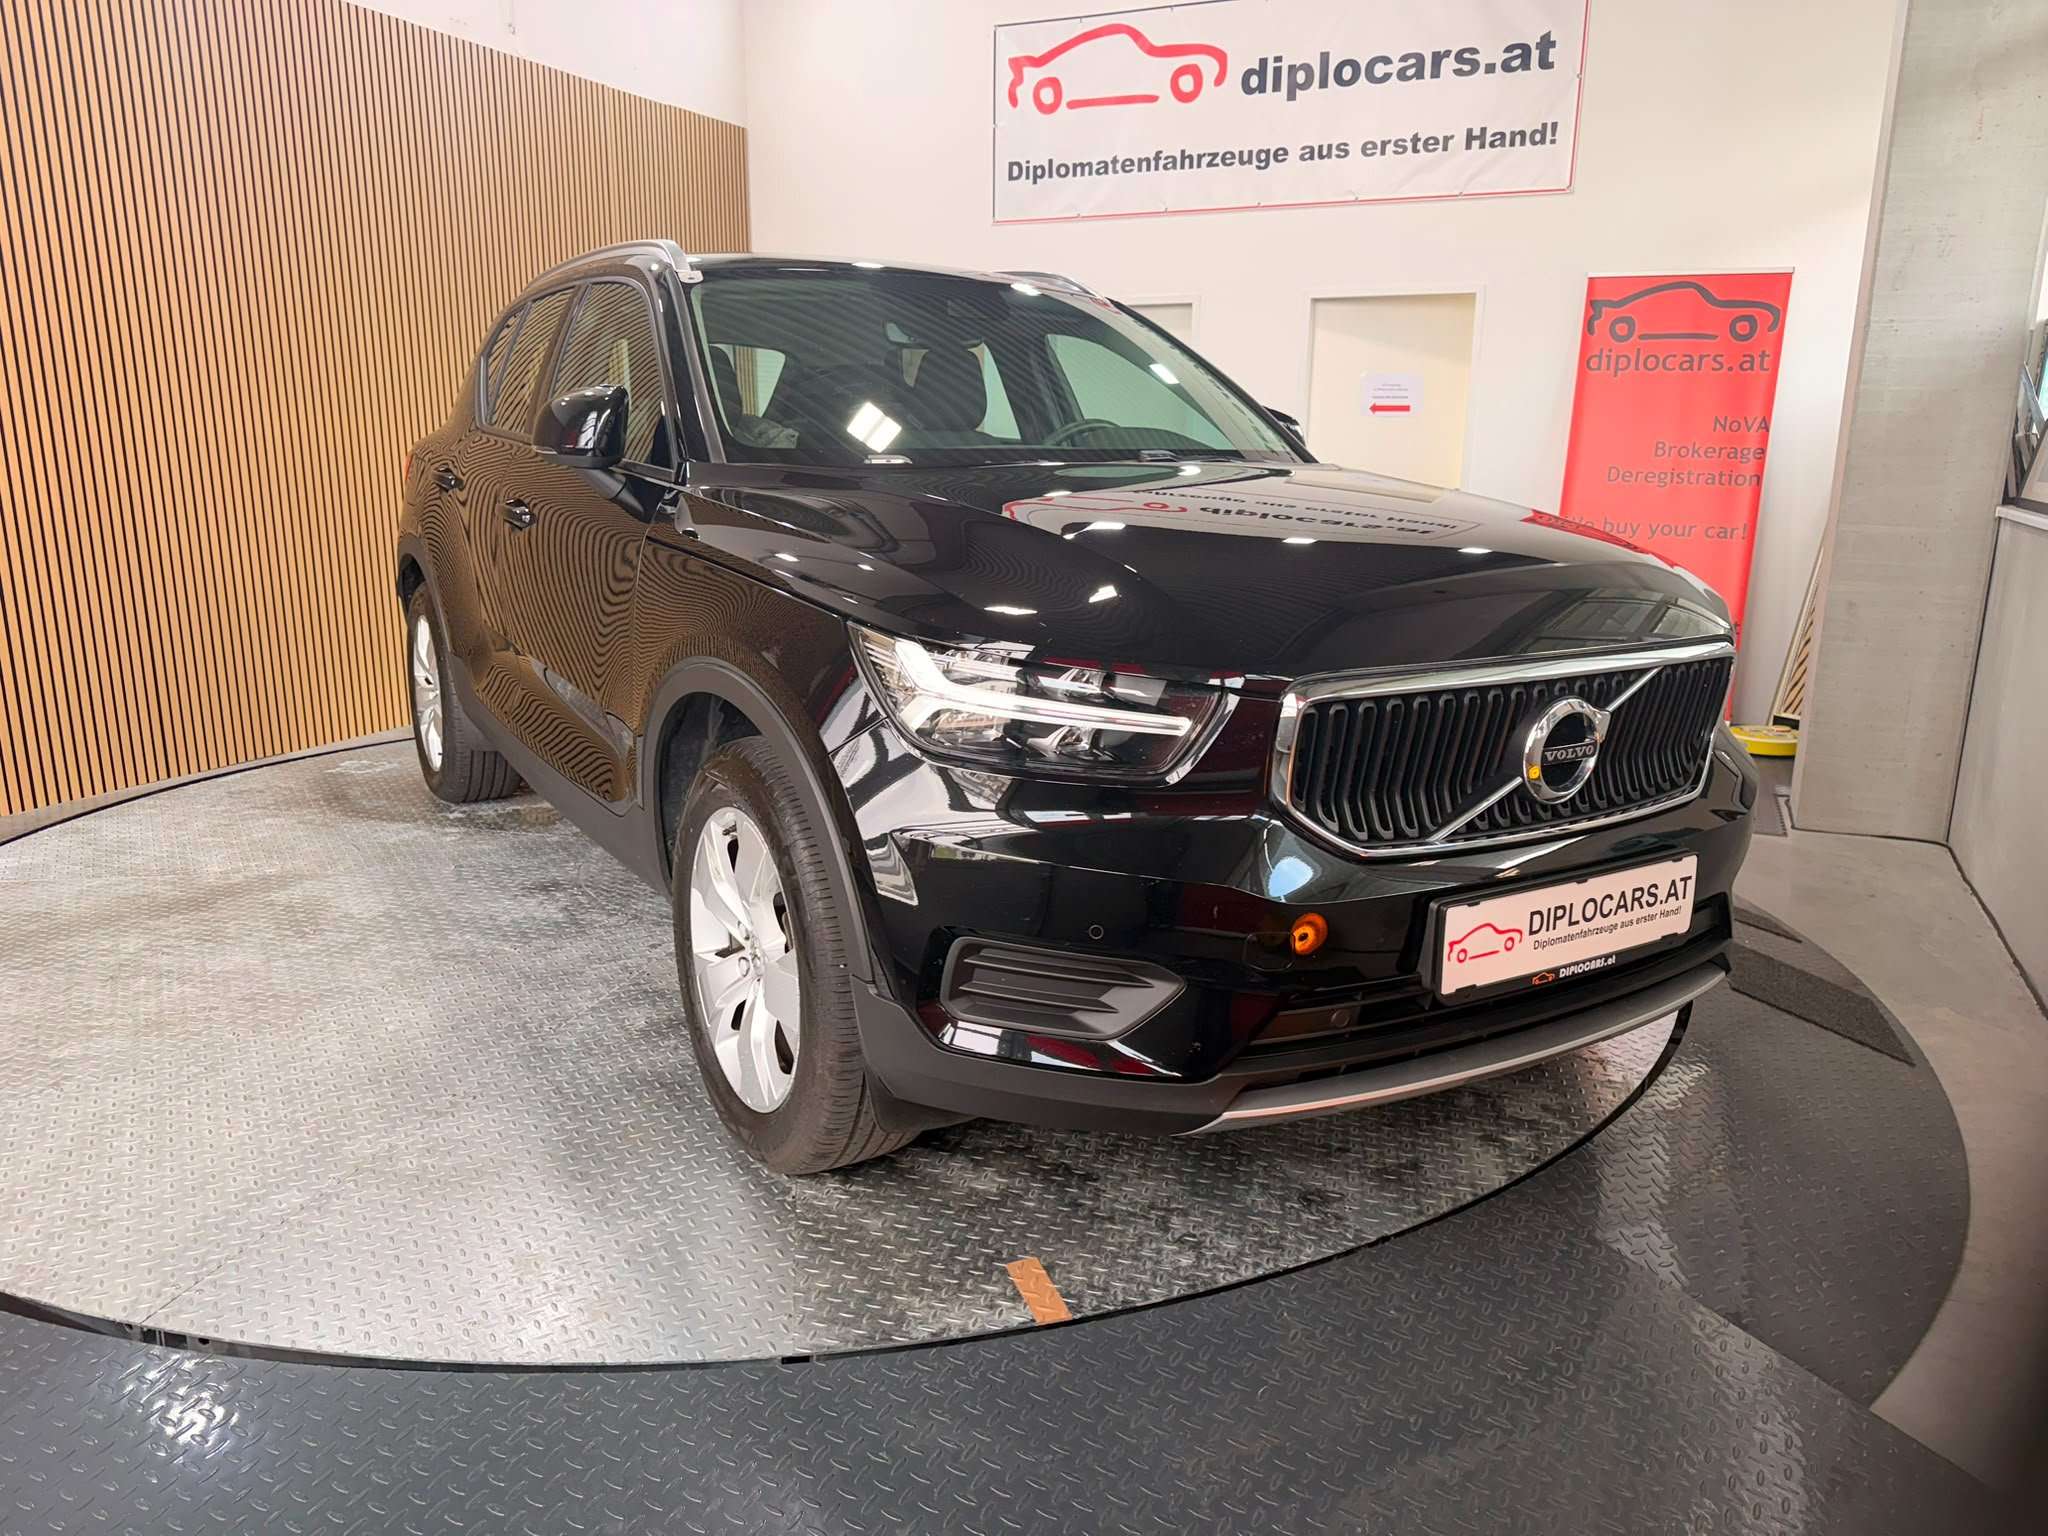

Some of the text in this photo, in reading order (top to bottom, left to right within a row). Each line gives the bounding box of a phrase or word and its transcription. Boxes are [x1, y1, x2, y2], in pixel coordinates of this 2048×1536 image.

[1241, 30, 1556, 101] diplocars.at
[1008, 121, 1558, 184] Diplomatenfahrzeuge aus erster Hand!
[1586, 348, 1771, 377] diplocars.at
[1712, 415, 1770, 433] NoVA
[1653, 441, 1766, 464] Brokerage
[1607, 466, 1761, 488] Deregistration
[1603, 516, 1640, 537] buy
[1648, 522, 1696, 540] your
[1704, 523, 1748, 540] car!
[1544, 745, 1594, 761] VOLVO
[1528, 875, 1693, 936] DIPLOCARS.AT
[1533, 906, 1682, 950] Diplomatenfahrzeuge aus erster Hand!
[1559, 955, 1616, 978] DIPLOCARS.at
